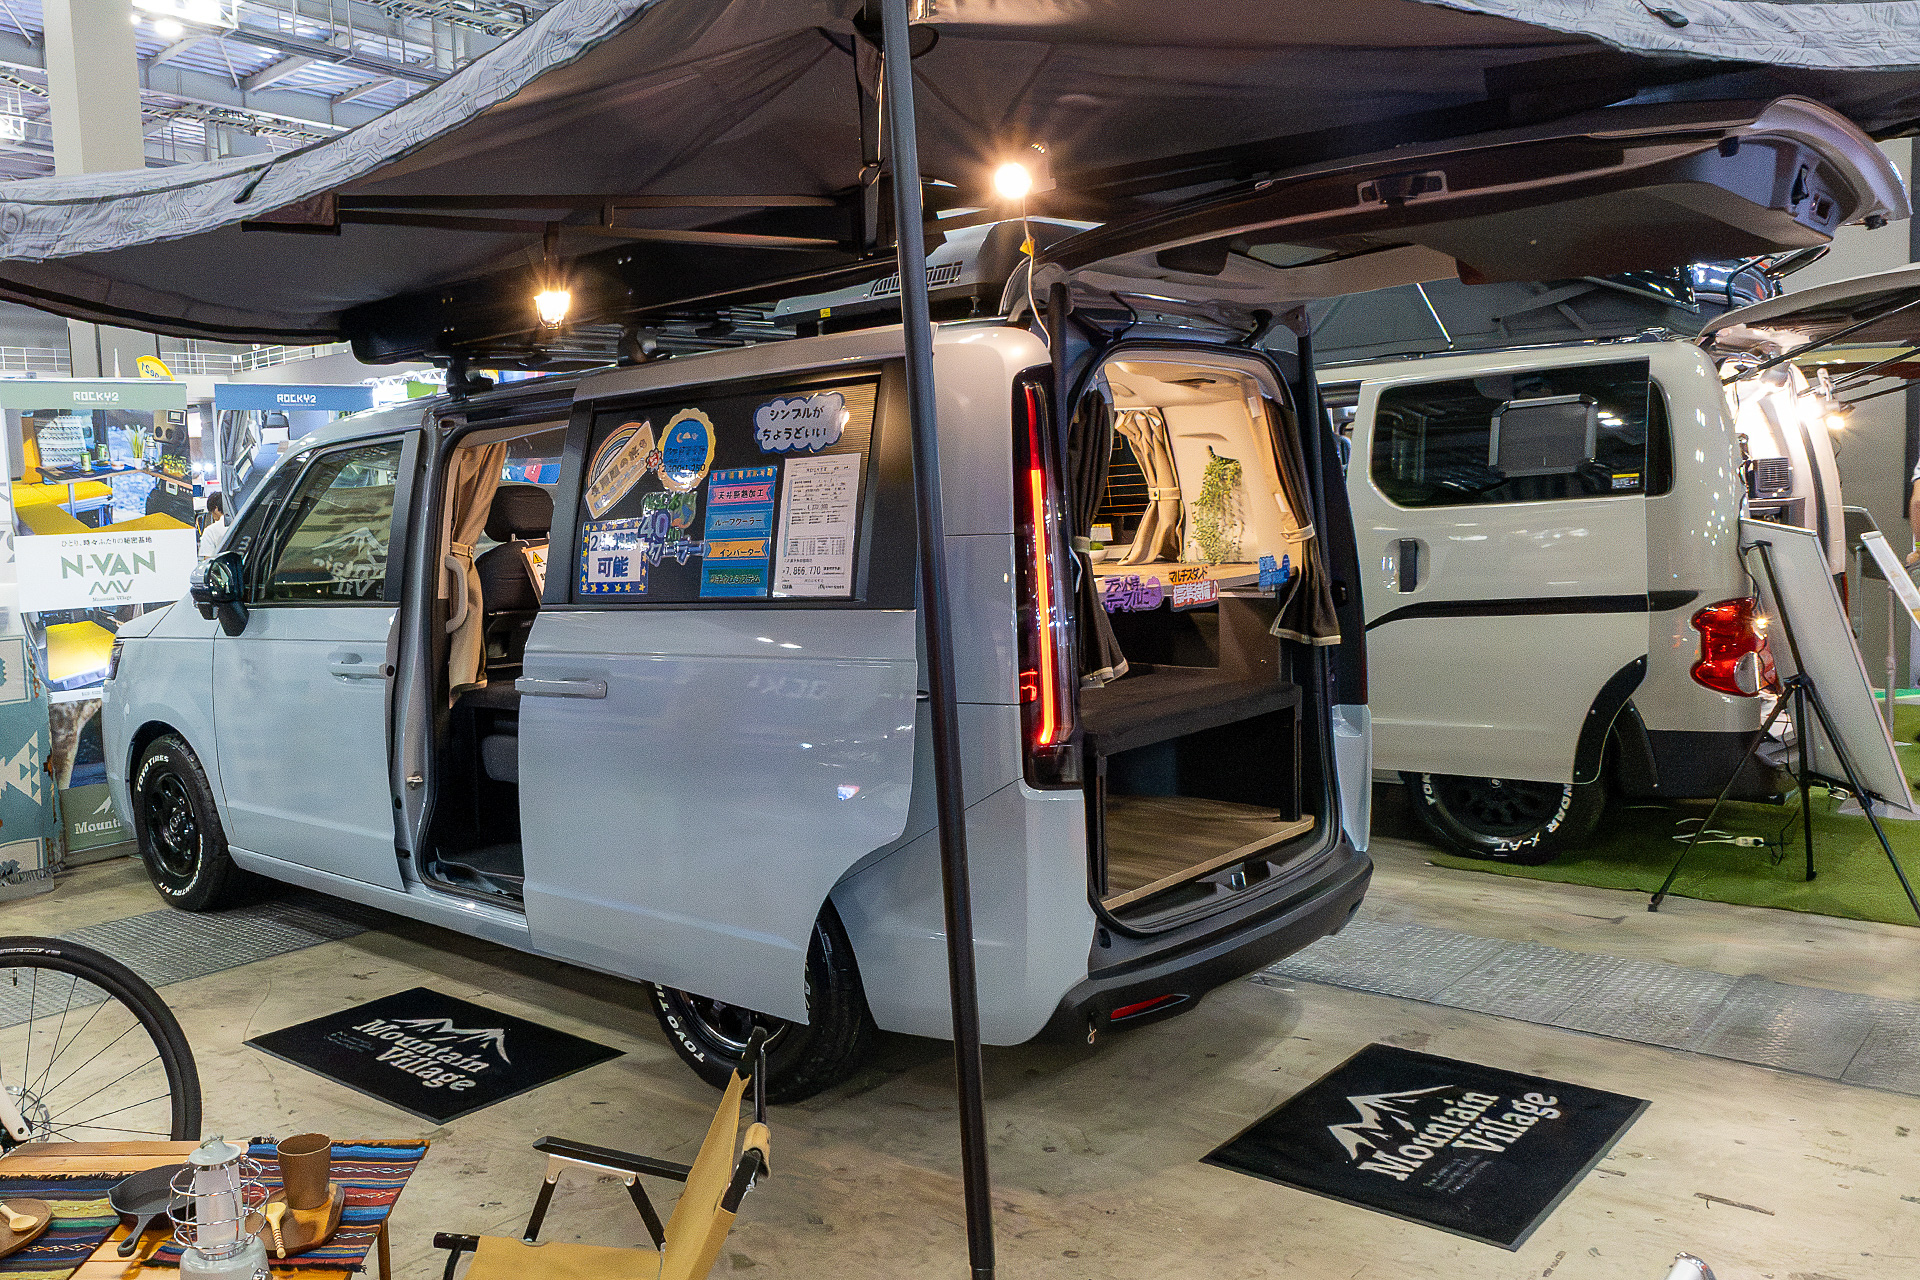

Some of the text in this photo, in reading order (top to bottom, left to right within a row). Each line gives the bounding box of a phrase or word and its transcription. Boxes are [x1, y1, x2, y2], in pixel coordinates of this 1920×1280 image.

[73, 391, 120, 402] ROCKY2
[276, 394, 317, 404] ROCKY2
[769, 405, 825, 421] シンプルが
[762, 426, 827, 441] ちょうどいい
[714, 516, 763, 527] ルーフクーラー
[719, 547, 761, 557] インバーター
[61, 550, 157, 579] N-VAN
[597, 555, 629, 578] 可能
[351, 1018, 491, 1074] Mountain
[667, 1015, 706, 1063] TOYO
[375, 1046, 478, 1092] Village
[1450, 1091, 1559, 1155] Village
[1357, 1091, 1501, 1182] Mountain
